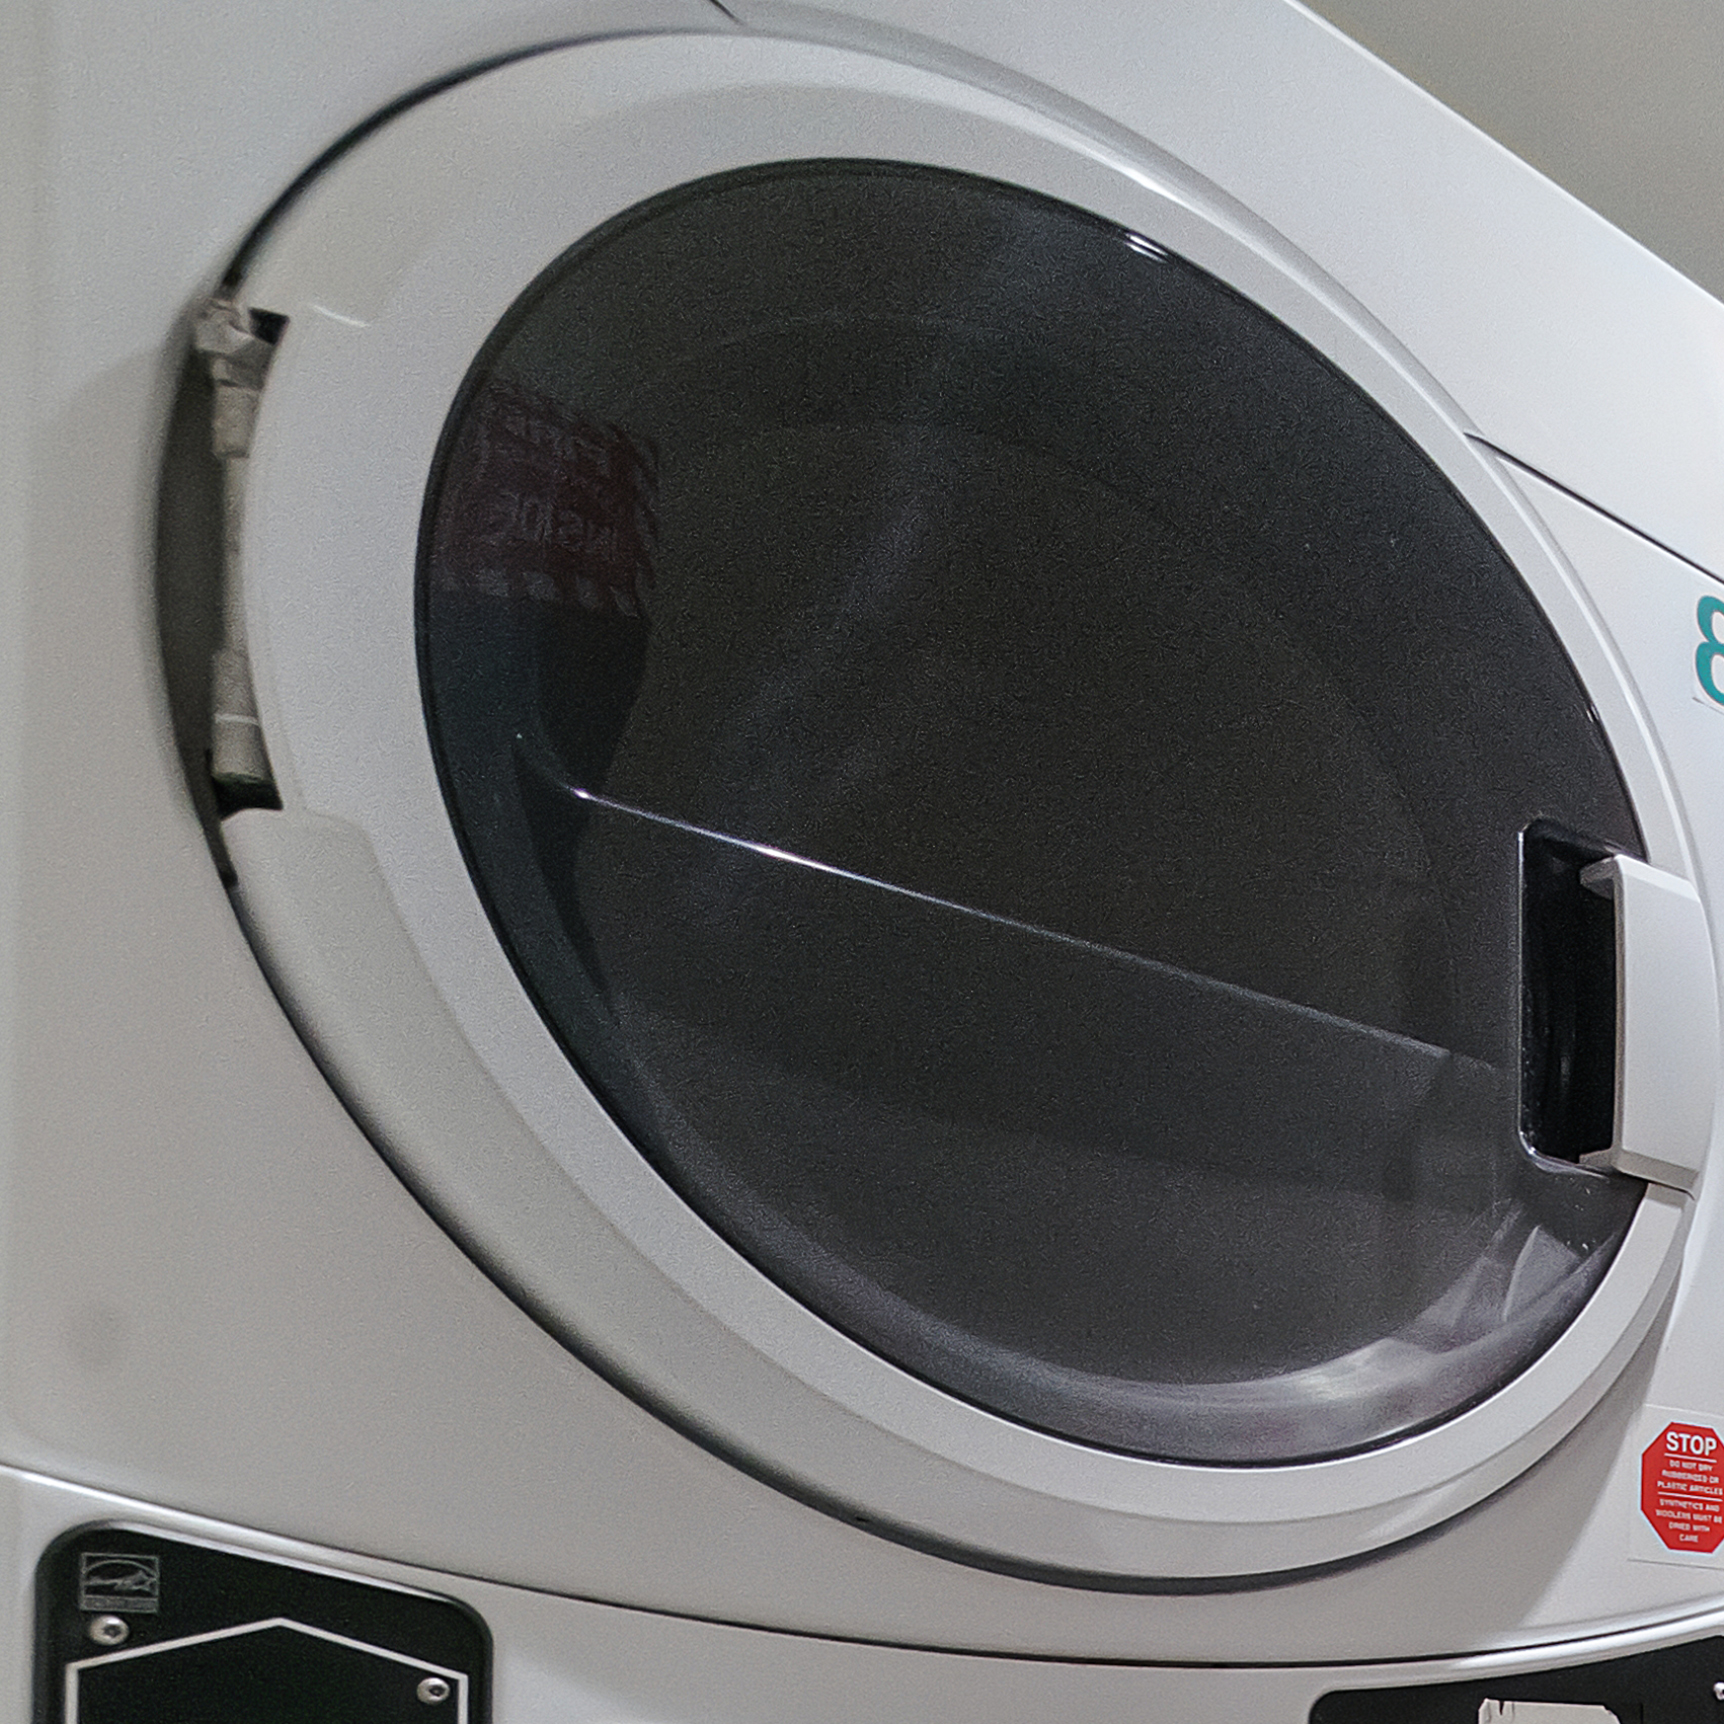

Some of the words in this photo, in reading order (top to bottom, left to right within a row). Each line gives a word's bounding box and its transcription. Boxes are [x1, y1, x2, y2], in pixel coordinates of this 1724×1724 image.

[1665, 1431, 1717, 1456] STOP
[1669, 1459, 1680, 1468] DO
[1682, 1461, 1697, 1471] NOT
[1657, 1480, 1687, 1492] PLASTIC
[1689, 1485, 1723, 1496] ARTICLES
